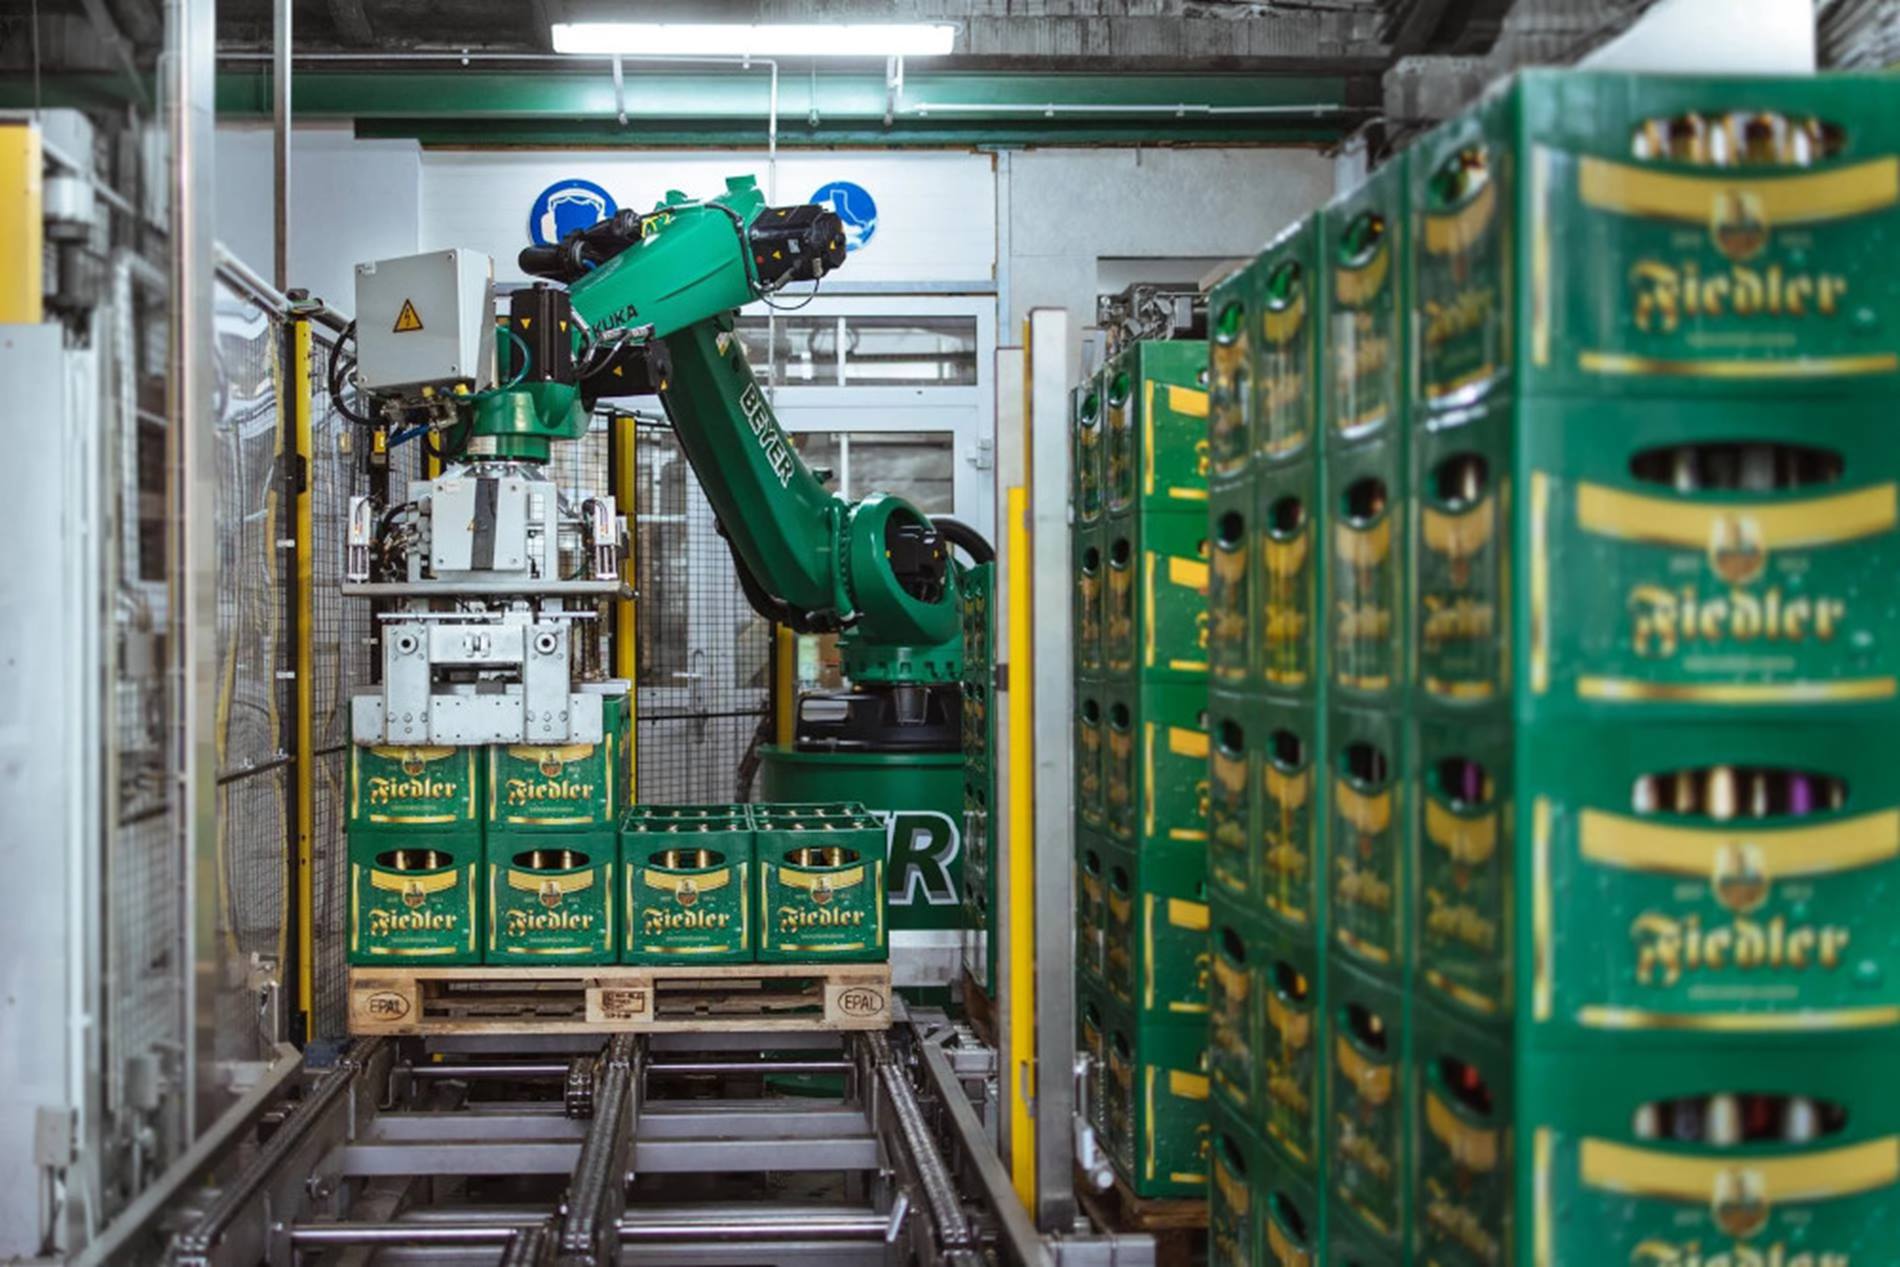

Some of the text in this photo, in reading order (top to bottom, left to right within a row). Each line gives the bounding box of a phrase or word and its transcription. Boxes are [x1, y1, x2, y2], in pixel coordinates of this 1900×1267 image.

[1632, 260, 1847, 333] Fiedler
[592, 304, 638, 337] KUKA
[739, 382, 795, 489] BEYER
[1630, 584, 1846, 655] Fiedler
[369, 777, 458, 806] Fiedler
[506, 778, 594, 807] Fiedler
[369, 908, 458, 937] Fiedler
[506, 908, 594, 937] Fiedler
[643, 907, 731, 936] Fiedler
[780, 905, 867, 934] Fiedler
[1634, 914, 1847, 985] Fiedler
[369, 998, 403, 1014] EPAL
[844, 994, 878, 1011] EPAL
